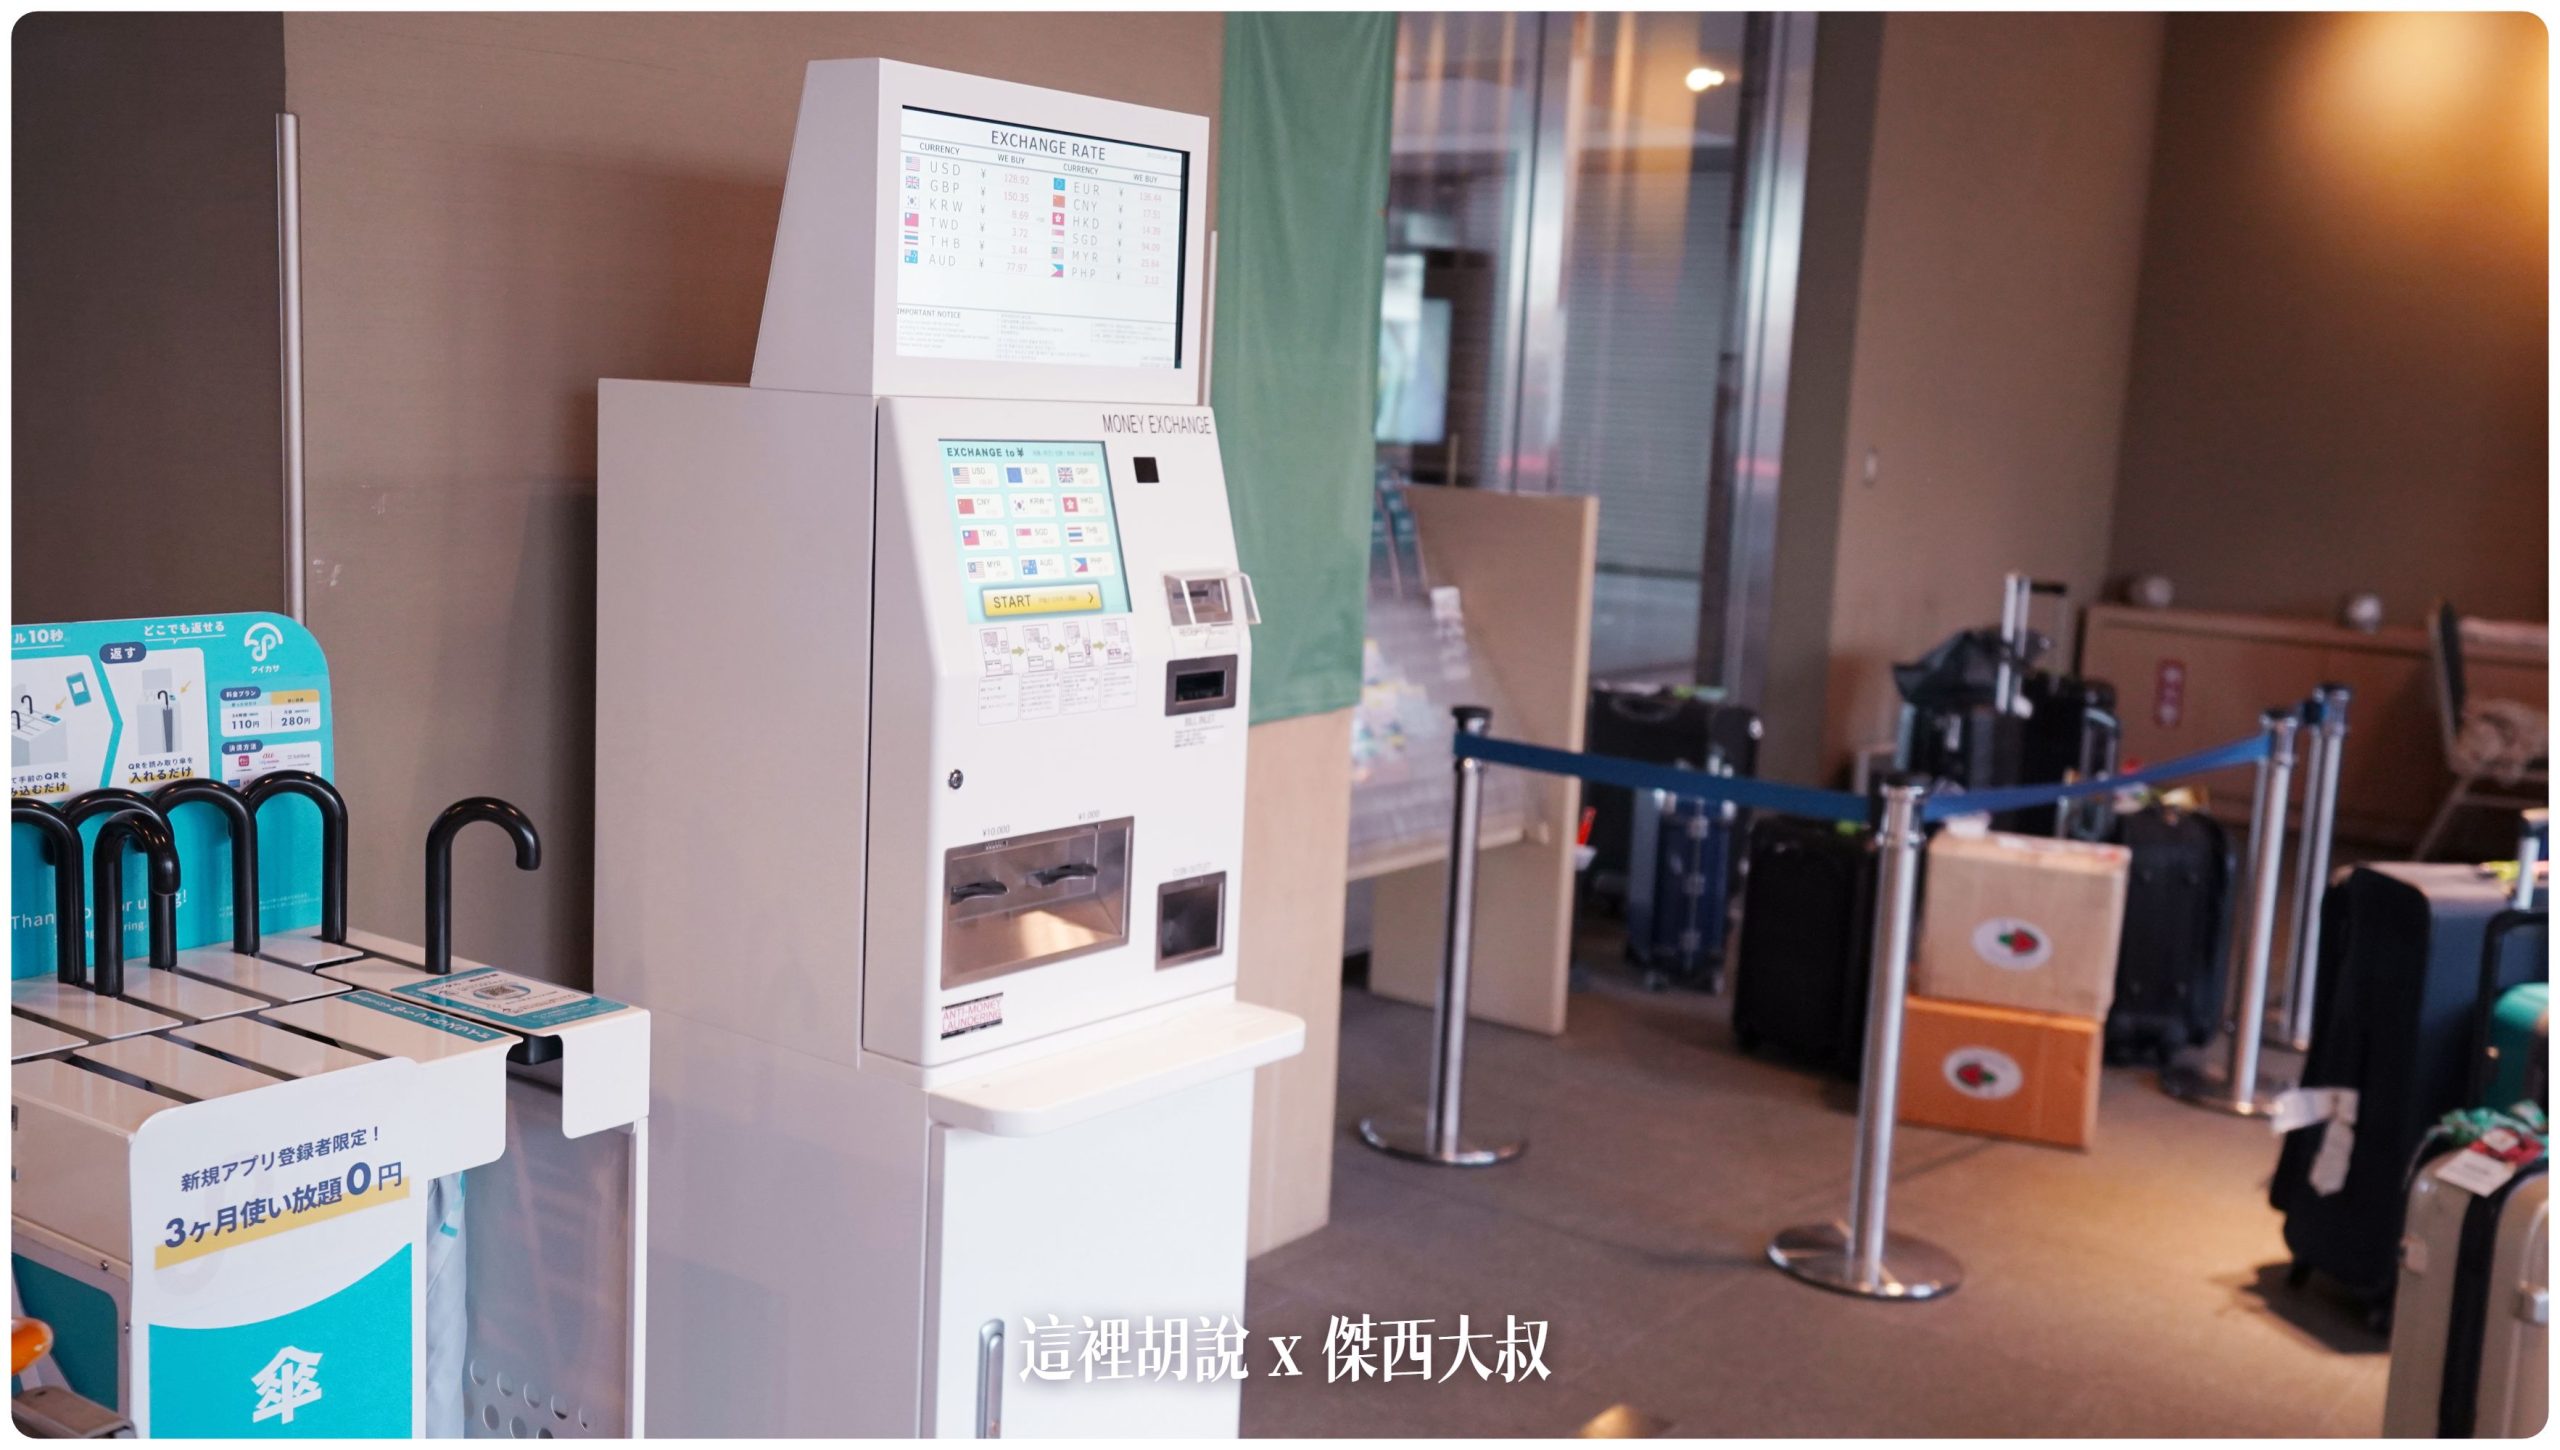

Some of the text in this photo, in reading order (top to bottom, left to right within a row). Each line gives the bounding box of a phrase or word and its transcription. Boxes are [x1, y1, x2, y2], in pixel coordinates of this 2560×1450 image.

[991, 130, 1106, 161] EXCHANGE RATE
[919, 142, 1159, 184] CURRENCY WE BUY CURRENCY WE BUY
[1011, 227, 1029, 238] 3.72
[897, 307, 961, 319] IMPORTANT NOTICE
[1102, 413, 1212, 434] MONEY EXCHANGE
[946, 447, 1002, 457] EXCHANGE
[1006, 448, 1015, 457] to
[971, 467, 986, 475] USD
[981, 529, 997, 537] TWD
[993, 594, 1031, 609] START
[143, 621, 225, 637] どこでも返せる
[109, 646, 137, 660] 返す
[250, 664, 281, 674] アイカサ
[225, 690, 256, 698] 料金プラン
[232, 720, 260, 730] 110円
[281, 716, 311, 727] 280円
[228, 743, 257, 753] 決済方法
[128, 756, 193, 770] QRを読み取り傘を
[129, 767, 193, 784] 入れるだけ
[12, 912, 55, 930] Than
[943, 999, 1001, 1019] ANTI-MONEY
[942, 1010, 1001, 1032] LAUNDERING
[180, 1126, 379, 1193] 新規アプリ登録者限定！
[251, 1345, 324, 1425] 傘
